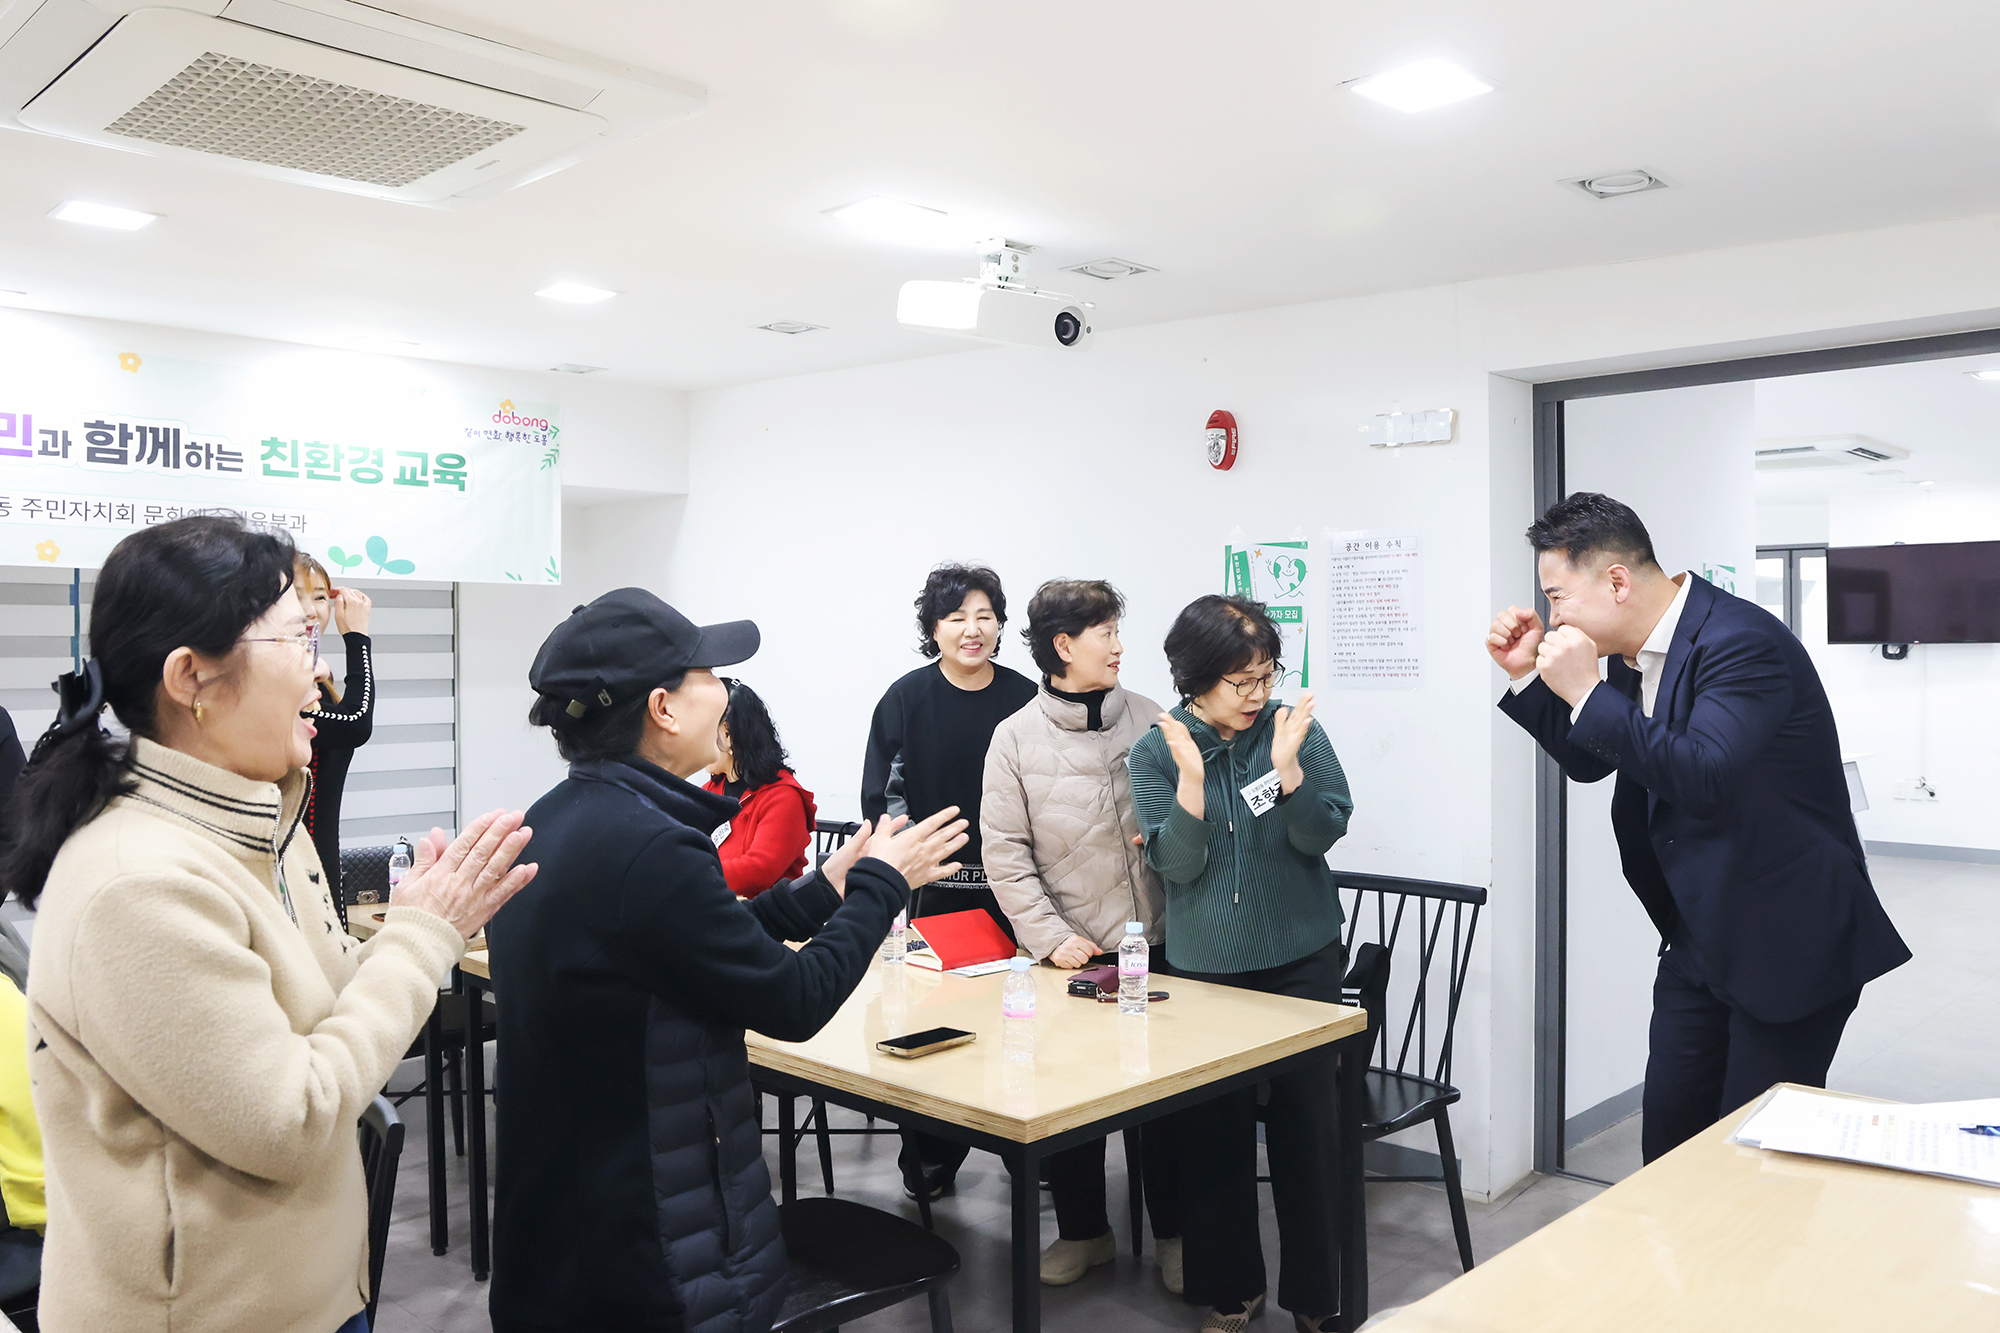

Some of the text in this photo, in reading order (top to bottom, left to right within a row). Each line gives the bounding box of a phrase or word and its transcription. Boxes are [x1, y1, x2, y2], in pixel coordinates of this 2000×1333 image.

[492, 410, 548, 431] dobong
[505, 430, 531, 444] 행복한
[534, 433, 548, 446] 도봉
[0, 412, 468, 492] 민과 함께하는 친환경 교육
[21, 498, 135, 524] 주민자치회
[1345, 539, 1402, 552] 공간 이용 수칙
[1267, 610, 1298, 619] 가자 모집
